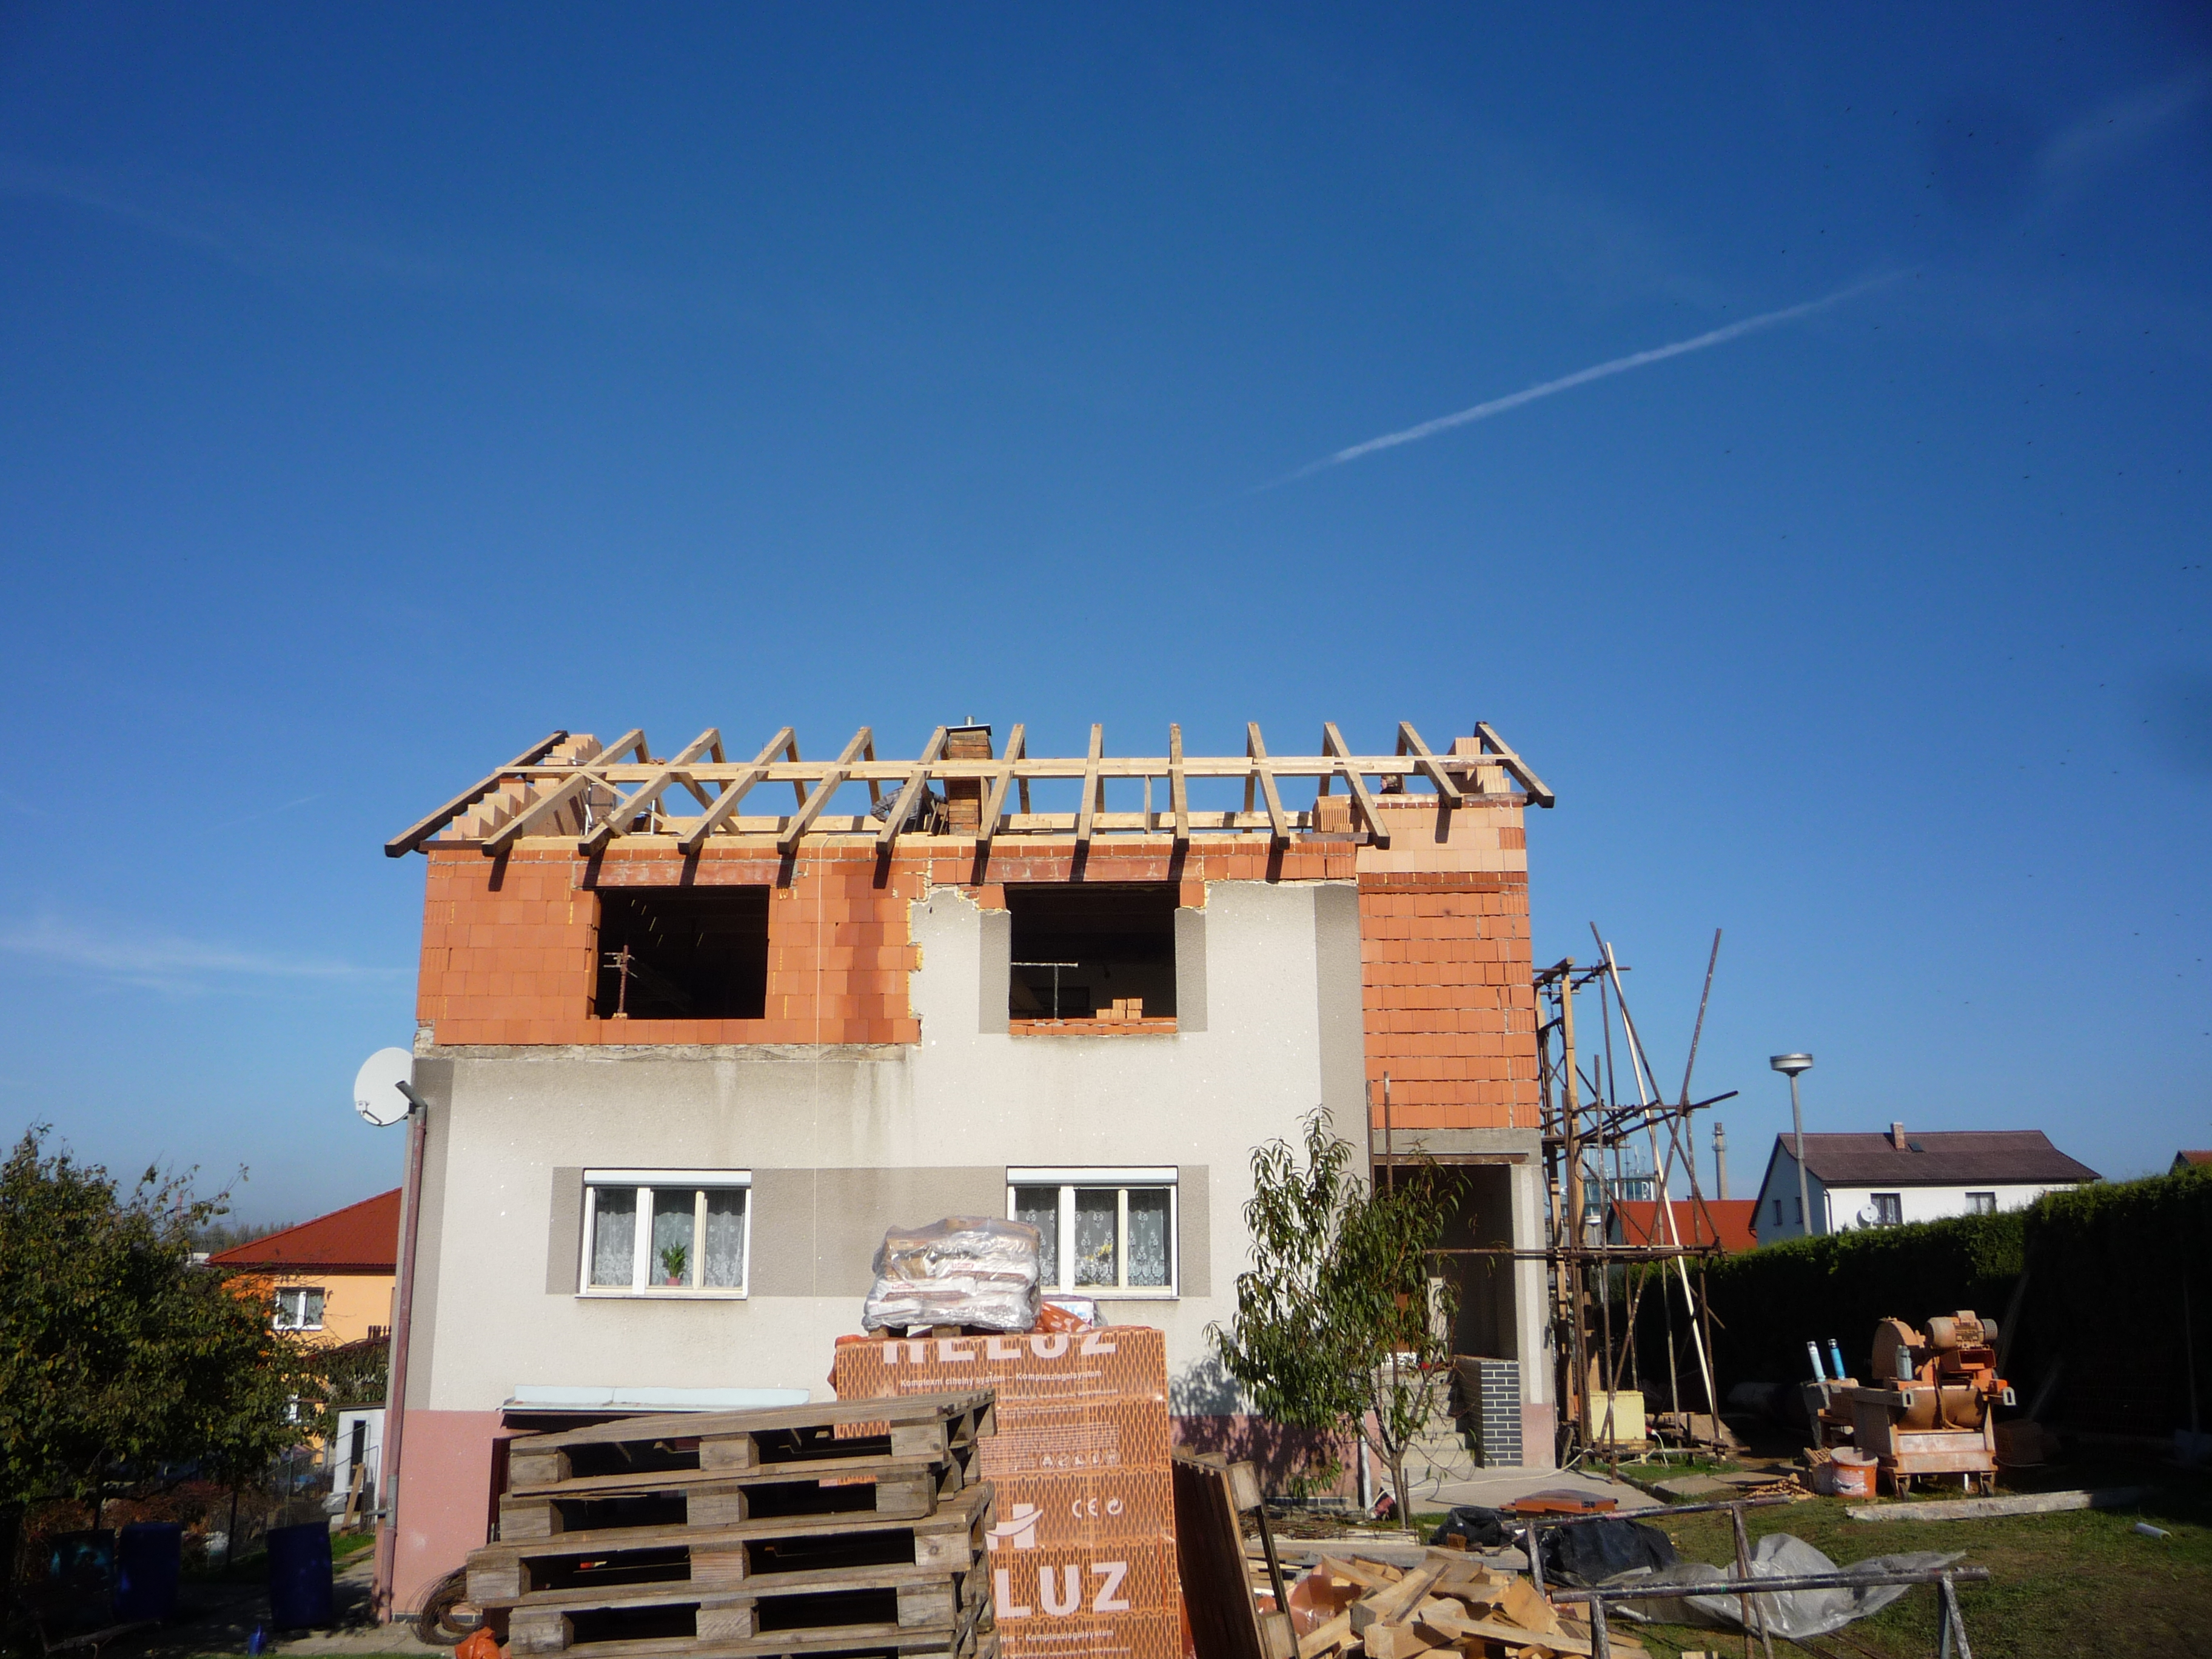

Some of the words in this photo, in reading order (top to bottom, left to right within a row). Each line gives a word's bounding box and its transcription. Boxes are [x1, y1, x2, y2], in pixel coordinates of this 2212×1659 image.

[976, 1374, 1005, 1384] systém
[1016, 1369, 1102, 1382] Komplexziegelsystem
[994, 1561, 1130, 1618] LUZ
[1000, 1634, 1015, 1643] tém
[1025, 1629, 1114, 1642] Komplexziegelsystem
